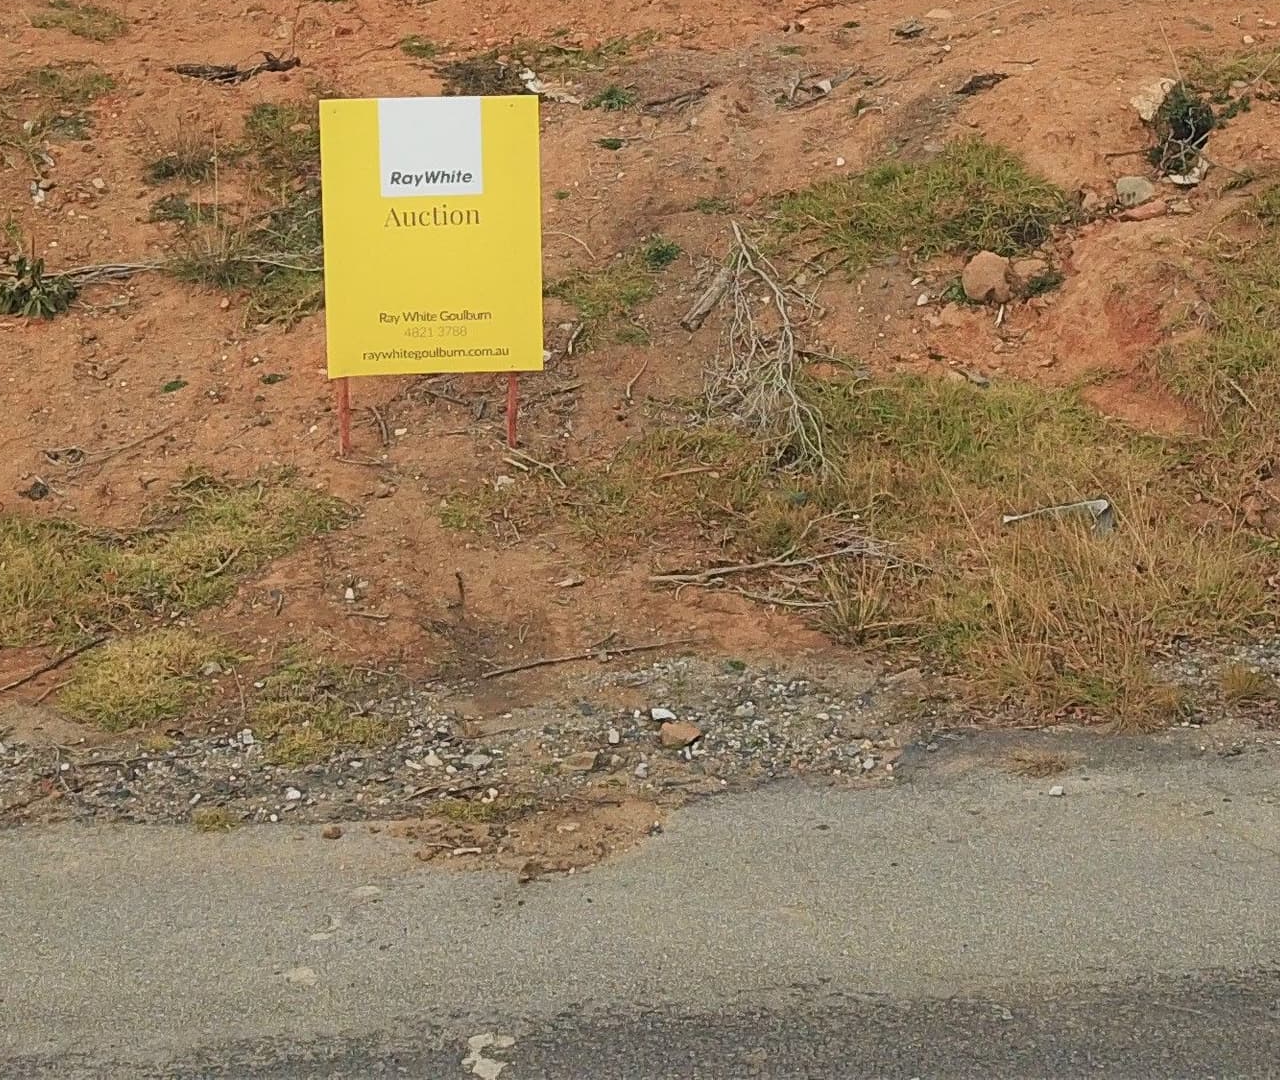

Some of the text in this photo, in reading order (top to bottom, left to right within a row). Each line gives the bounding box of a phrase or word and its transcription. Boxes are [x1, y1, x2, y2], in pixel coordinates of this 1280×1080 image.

[384, 204, 480, 227] Auction
[379, 312, 400, 325] Ray
[402, 311, 438, 323] White
[404, 327, 433, 338] 4821
